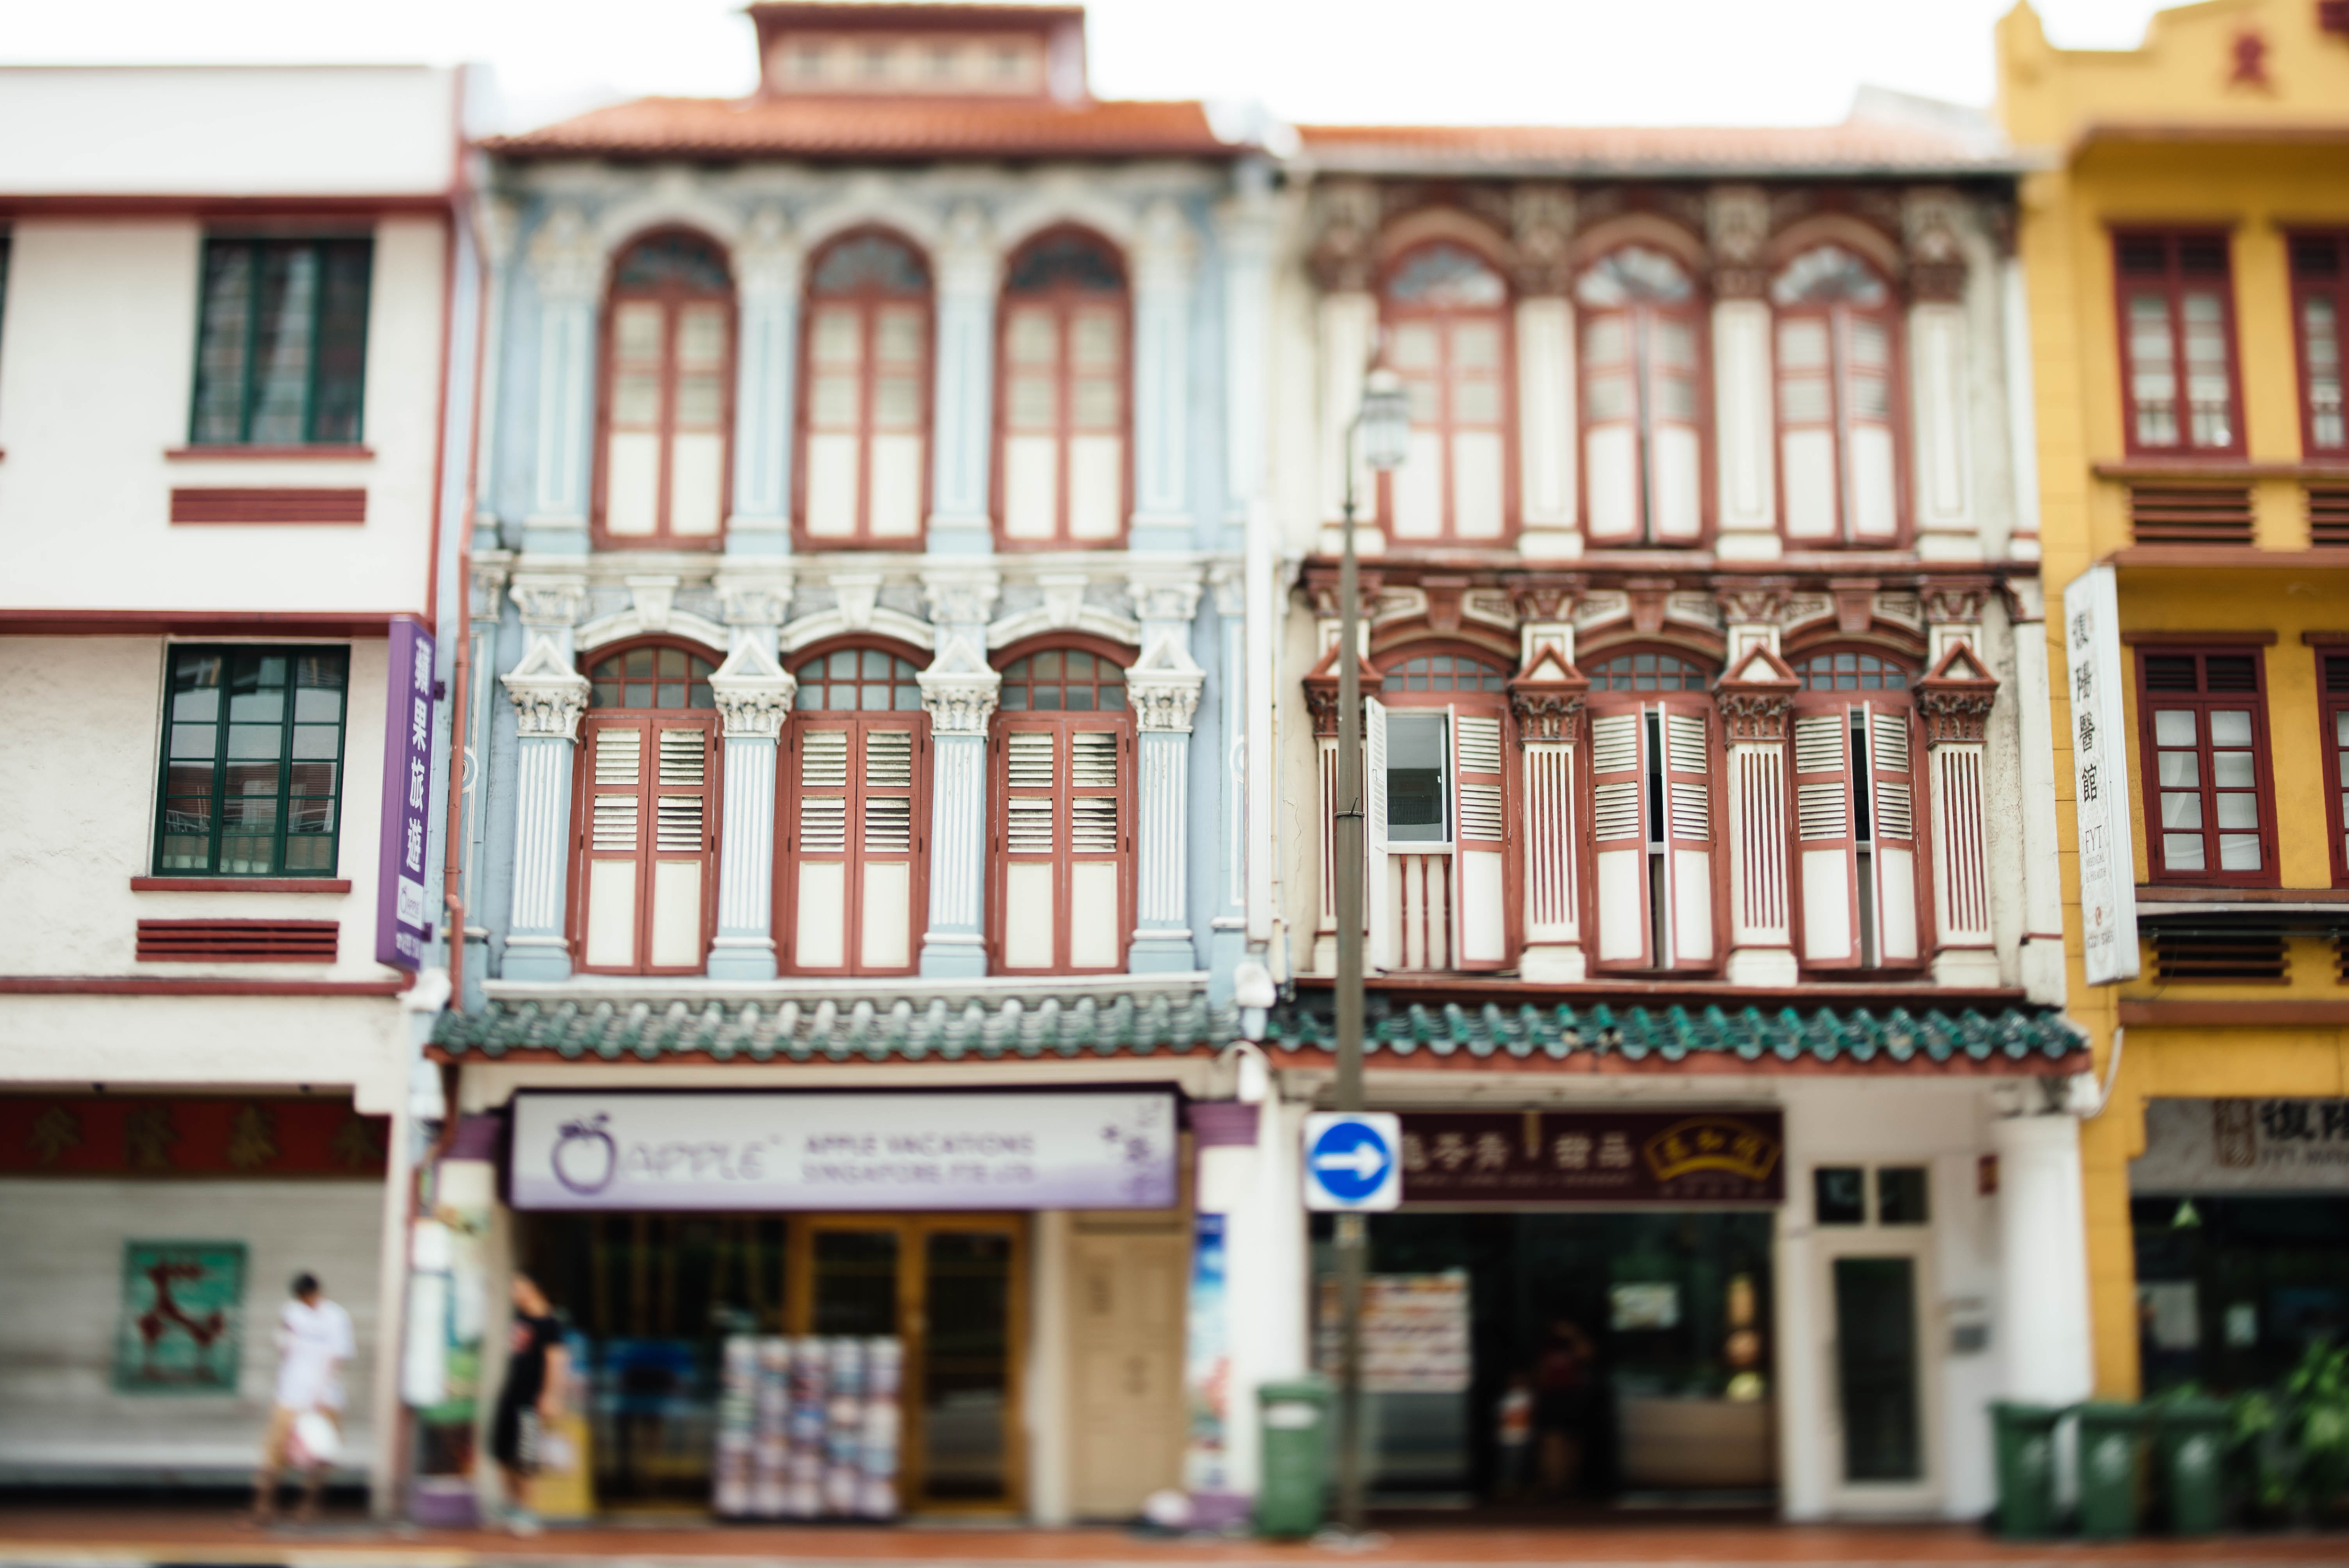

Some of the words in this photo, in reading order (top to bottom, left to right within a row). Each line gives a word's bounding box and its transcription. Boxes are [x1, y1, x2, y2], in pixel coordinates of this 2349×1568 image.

[2085, 825, 2102, 853] FYT
[2086, 853, 2105, 868] MEDICAL
[2091, 867, 2107, 881] HEALTH
[804, 1131, 877, 1155] APPLE
[886, 1130, 1035, 1155] VACATIONS
[624, 1139, 766, 1180] APPLE
[800, 1162, 941, 1185] SINGAPORE
